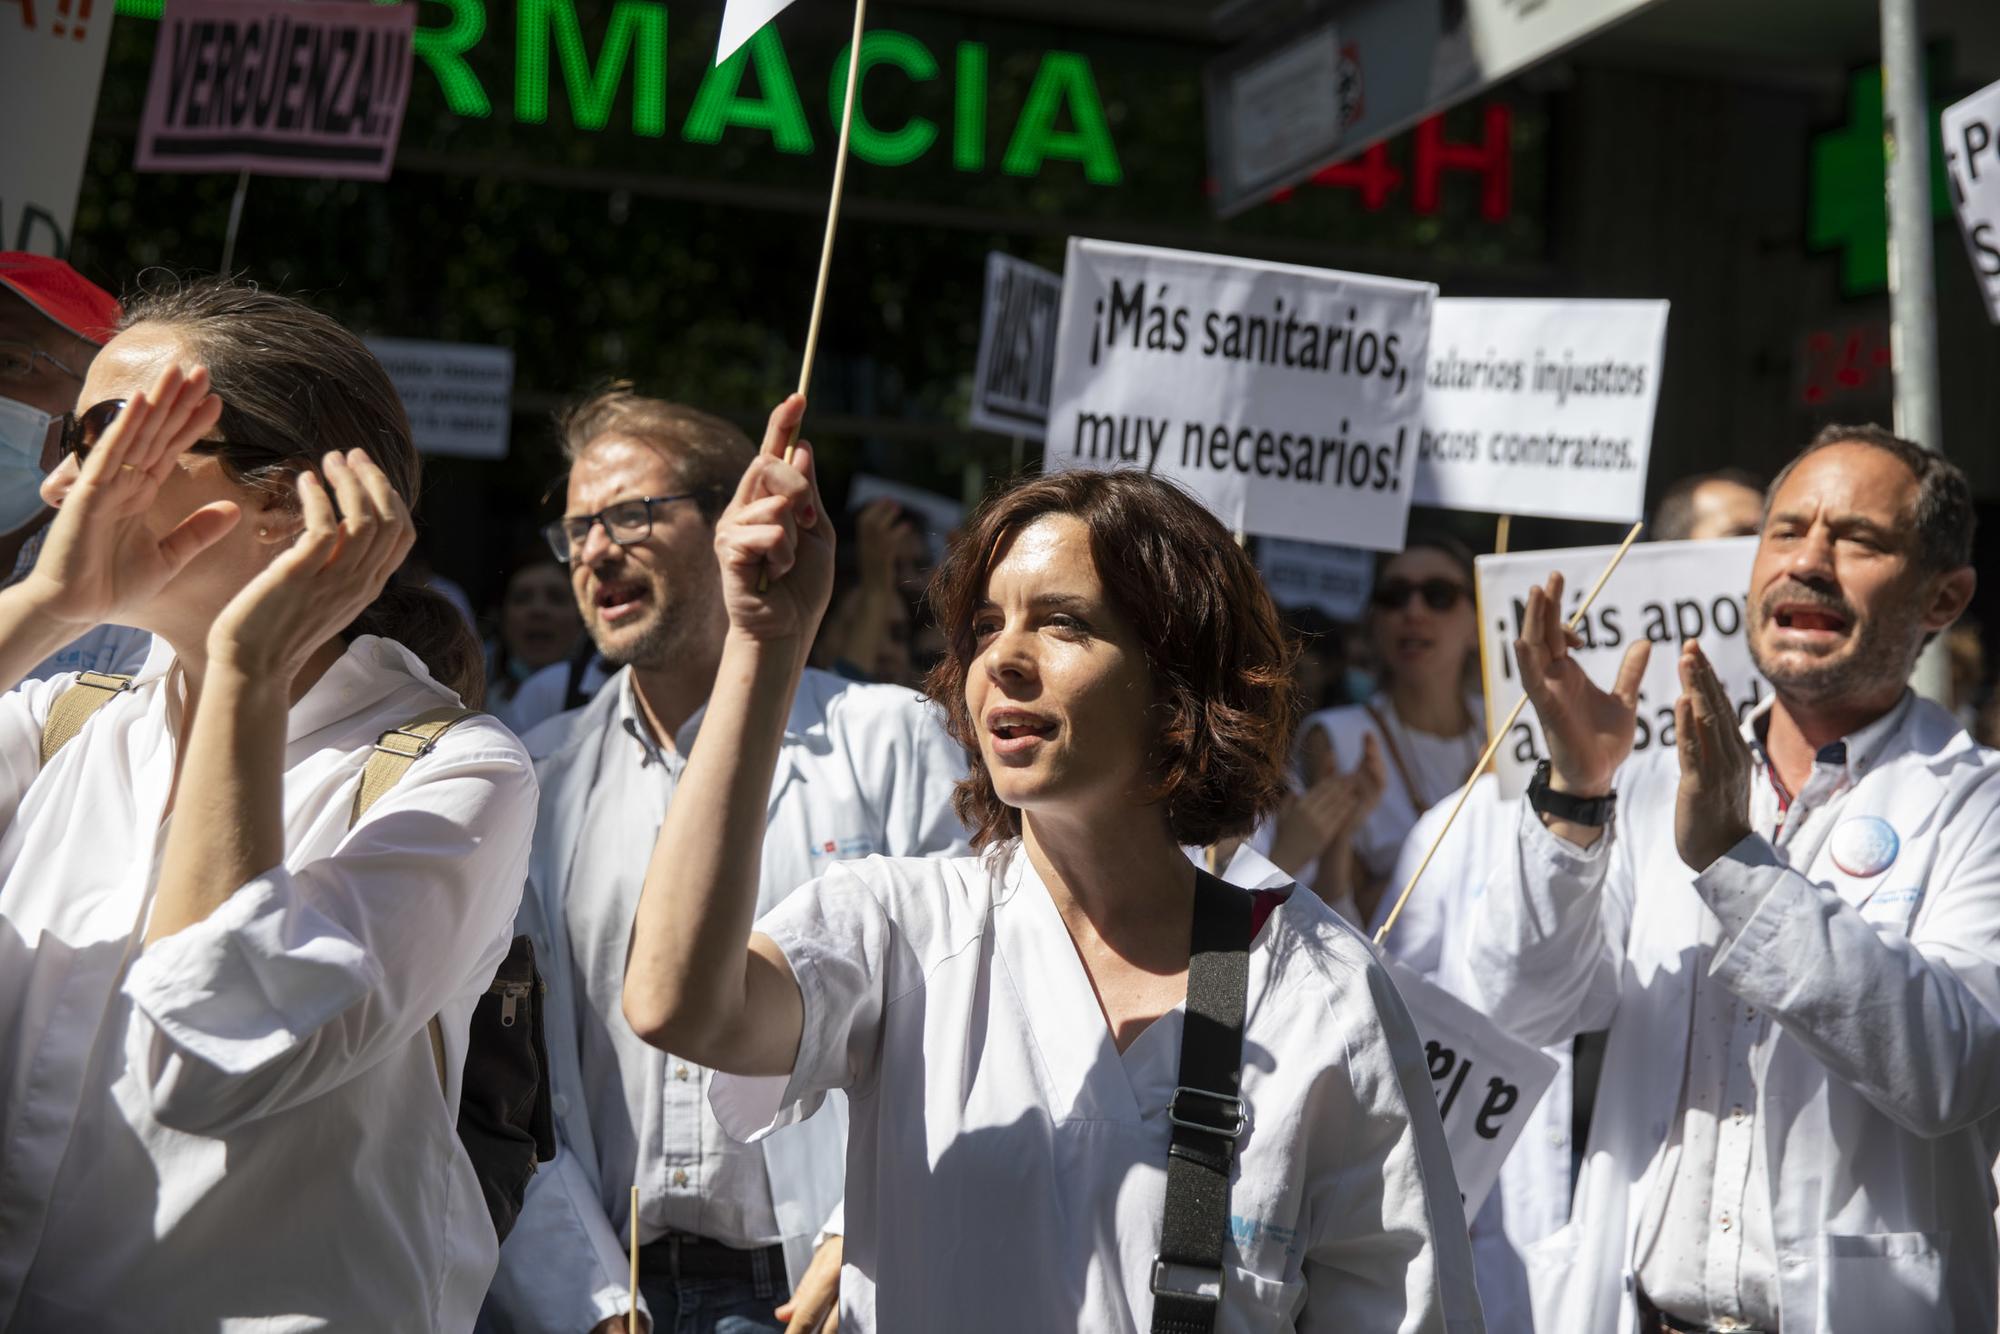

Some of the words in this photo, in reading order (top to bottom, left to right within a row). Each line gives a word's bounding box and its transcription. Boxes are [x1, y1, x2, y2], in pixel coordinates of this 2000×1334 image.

[1090, 278, 1190, 366] ¡Más
[1203, 297, 1408, 394] sanitarios,
[1427, 345, 1524, 391] alarios
[1532, 346, 1647, 406] injustos
[1074, 410, 1168, 472] muy
[1182, 417, 1405, 493] necesarios!
[1418, 427, 1479, 461] ocos
[1642, 594, 1750, 656] apo
